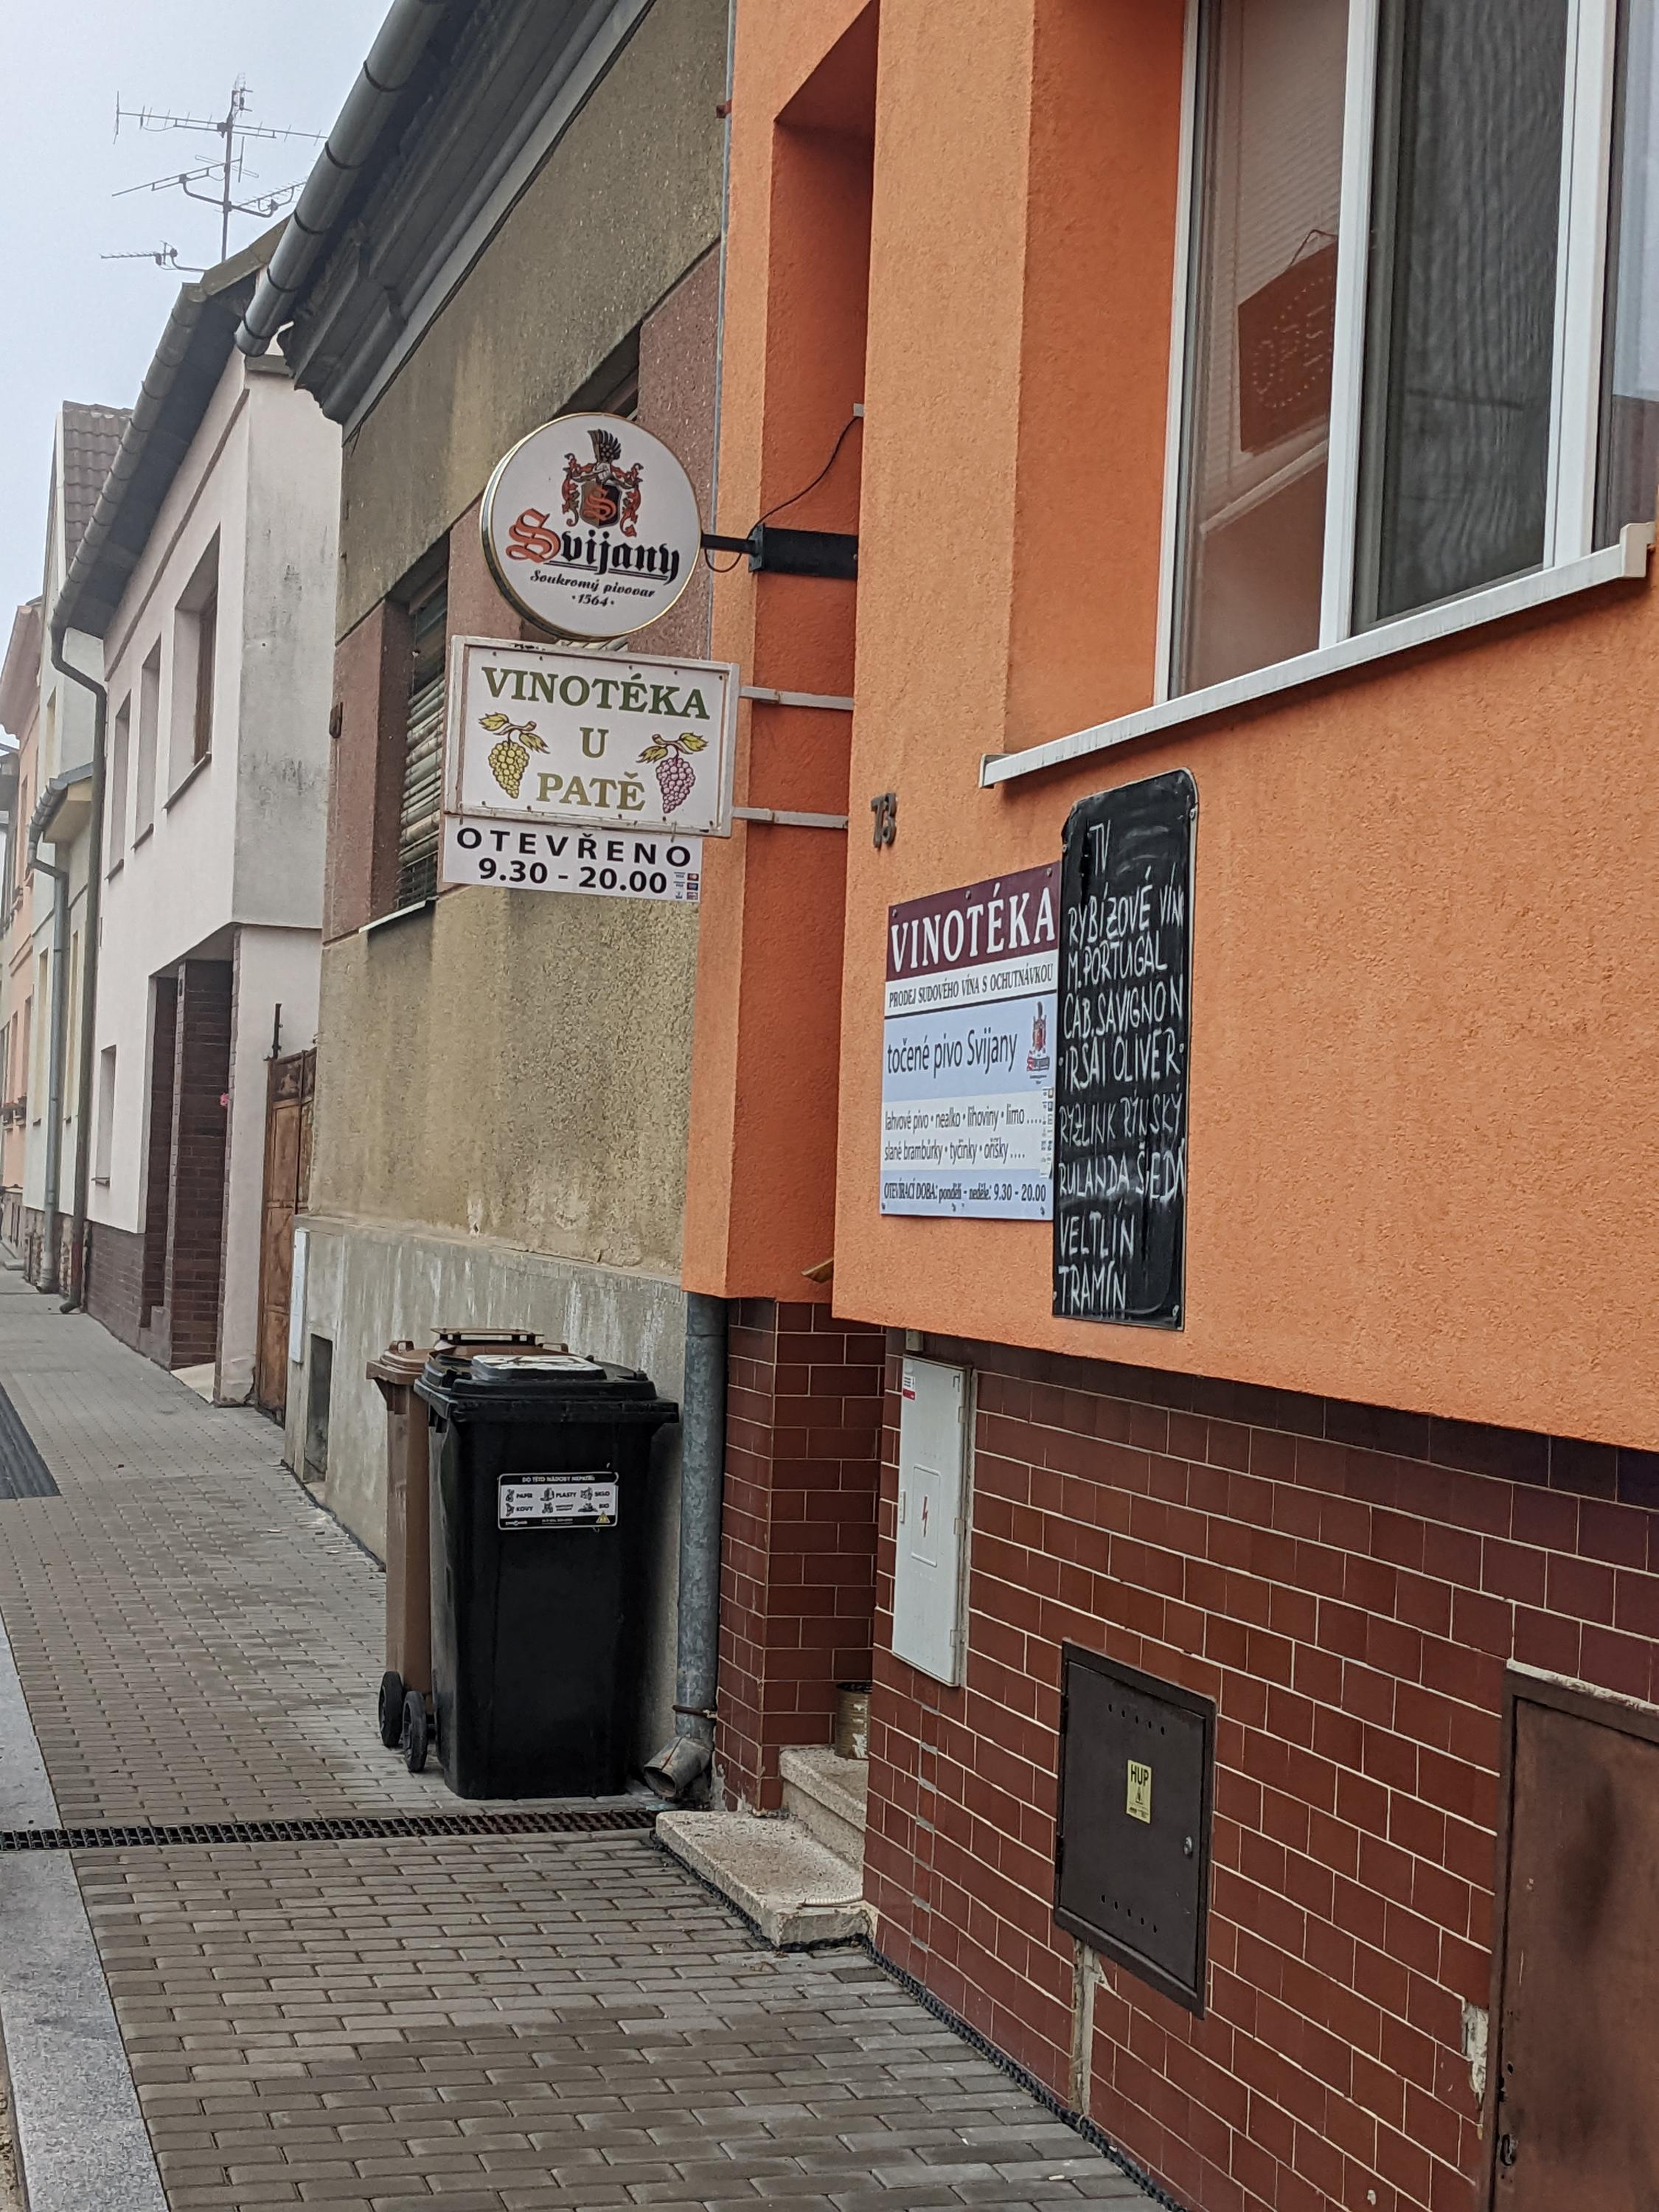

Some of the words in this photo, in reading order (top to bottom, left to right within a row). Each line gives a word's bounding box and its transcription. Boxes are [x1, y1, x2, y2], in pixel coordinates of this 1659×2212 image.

[505, 508, 680, 585] Svijany
[530, 570, 599, 592] Soukromý
[603, 582, 655, 598] pivovar
[481, 667, 710, 720] VINOTÉKA
[579, 727, 609, 758] U
[536, 771, 646, 811] PATĚ
[456, 827, 691, 868] OTEVŘENO
[479, 858, 548, 883] 9.30
[579, 866, 667, 894] 20.00
[891, 882, 1056, 973] VINOTÉKA
[1068, 866, 1153, 950] RYBÍZOVÉ
[888, 987, 917, 1009] PRODEJ
[918, 978, 959, 1004] SUDOVÉHO
[961, 973, 980, 995] VÍNA
[982, 975, 987, 992] S
[990, 963, 1054, 992] OCHUTNÁVKOU
[887, 1035, 930, 1074] točené
[934, 1034, 962, 1078] pivo
[967, 1027, 1018, 1074] Svijany
[1113, 1027, 1181, 1082] OLIVER
[885, 1110, 911, 1131] lahvové
[913, 1110, 929, 1133] pivo
[935, 1107, 961, 1128] nealko
[967, 1105, 999, 1131] lihoviny
[1006, 1104, 1024, 1124] limo
[1059, 1102, 1116, 1147] RYZLINK
[1120, 1083, 1183, 1138] RÝNSKÝ
[885, 1141, 902, 1161] slané
[950, 1138, 977, 1165] tyčinky
[994, 1183, 1012, 1201] 9.30
[1021, 1183, 1046, 1201] 20.00
[1058, 1152, 1130, 1197] RULANDA
[1060, 1198, 1135, 1258] VELTLÍN
[1058, 1259, 1127, 1315] TRAMÍN
[1130, 1764, 1149, 1787] HUP
